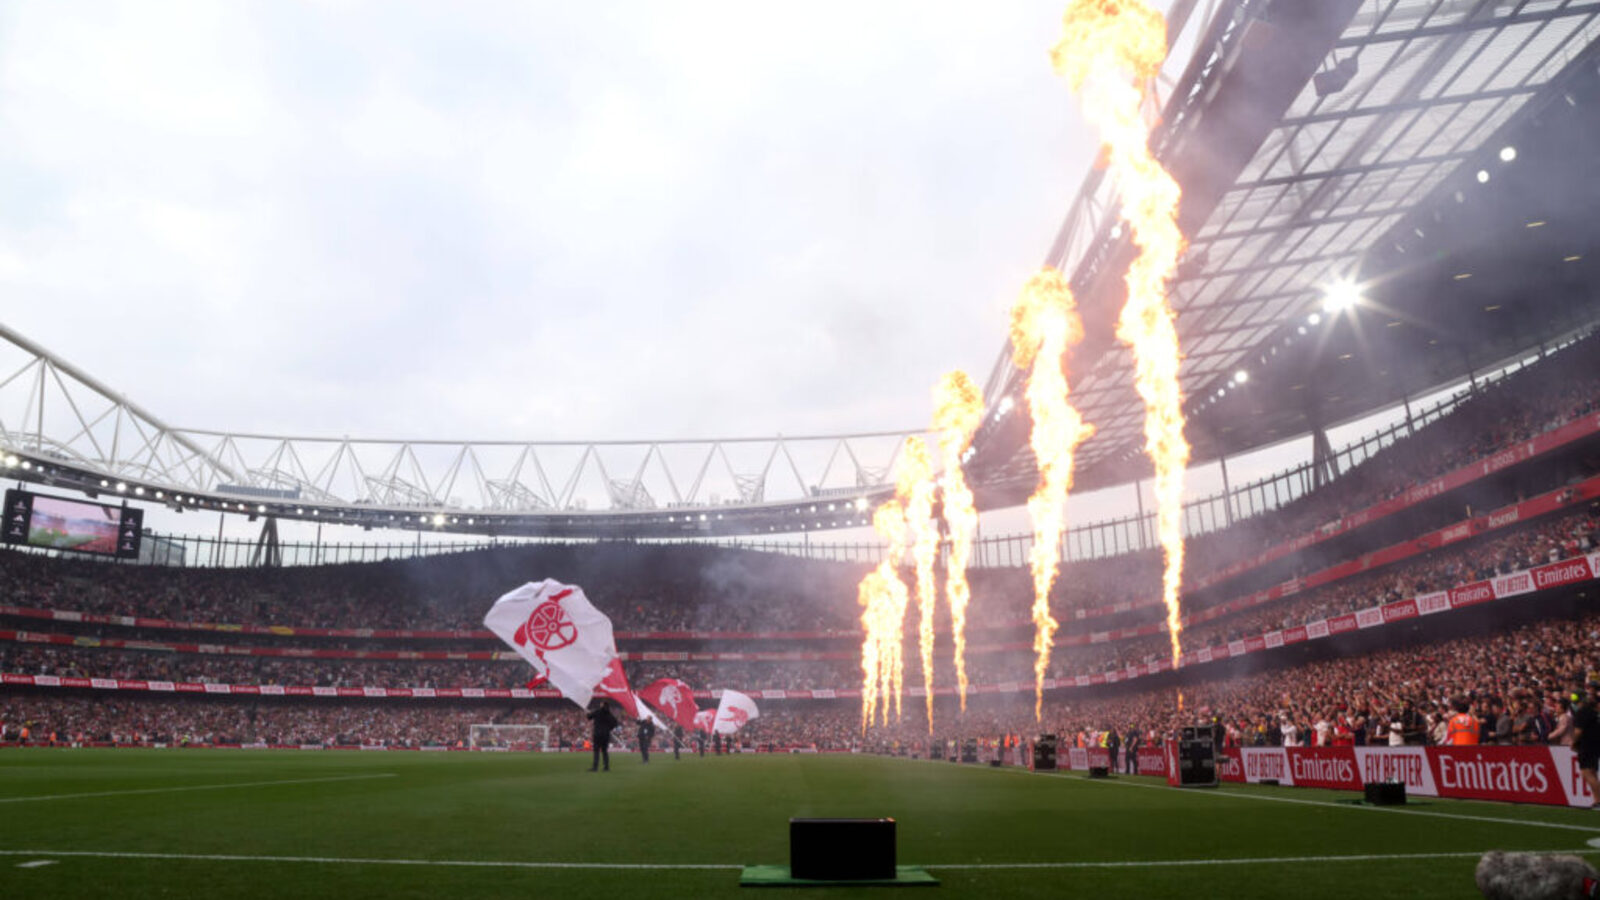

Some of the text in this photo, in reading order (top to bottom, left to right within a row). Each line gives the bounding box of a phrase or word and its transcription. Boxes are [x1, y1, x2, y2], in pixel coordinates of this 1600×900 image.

[1488, 507, 1518, 528] Arsenal
[1537, 564, 1586, 586] Emirates
[1452, 587, 1489, 605] Emirates
[1247, 752, 1258, 777] FLY
[1259, 752, 1285, 778] BETTER
[1292, 753, 1354, 782] Emirates
[1365, 753, 1423, 787] FLY BETTER
[1438, 754, 1548, 793] Emirates
